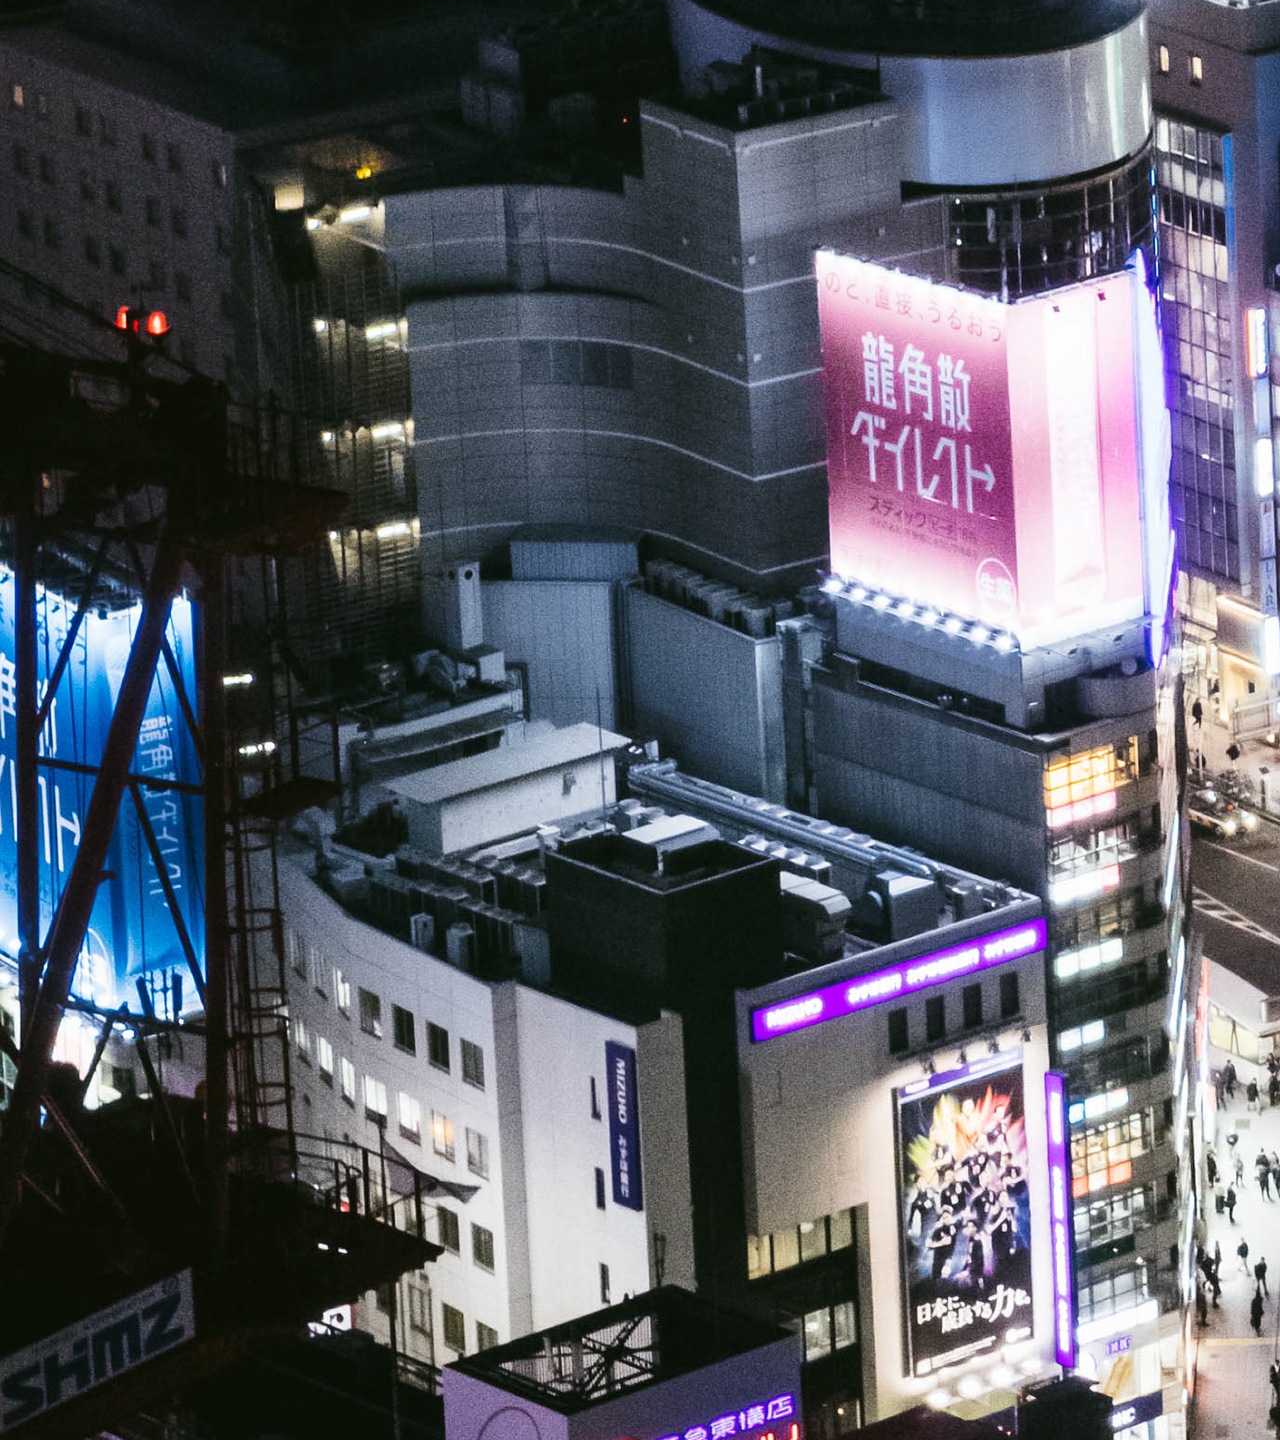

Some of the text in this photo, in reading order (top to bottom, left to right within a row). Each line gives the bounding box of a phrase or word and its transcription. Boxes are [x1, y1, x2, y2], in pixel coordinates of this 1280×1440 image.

[861, 331, 972, 432] 龍角散
[850, 411, 996, 514] ダイレクト
[615, 1057, 628, 1124] MIZUHO
